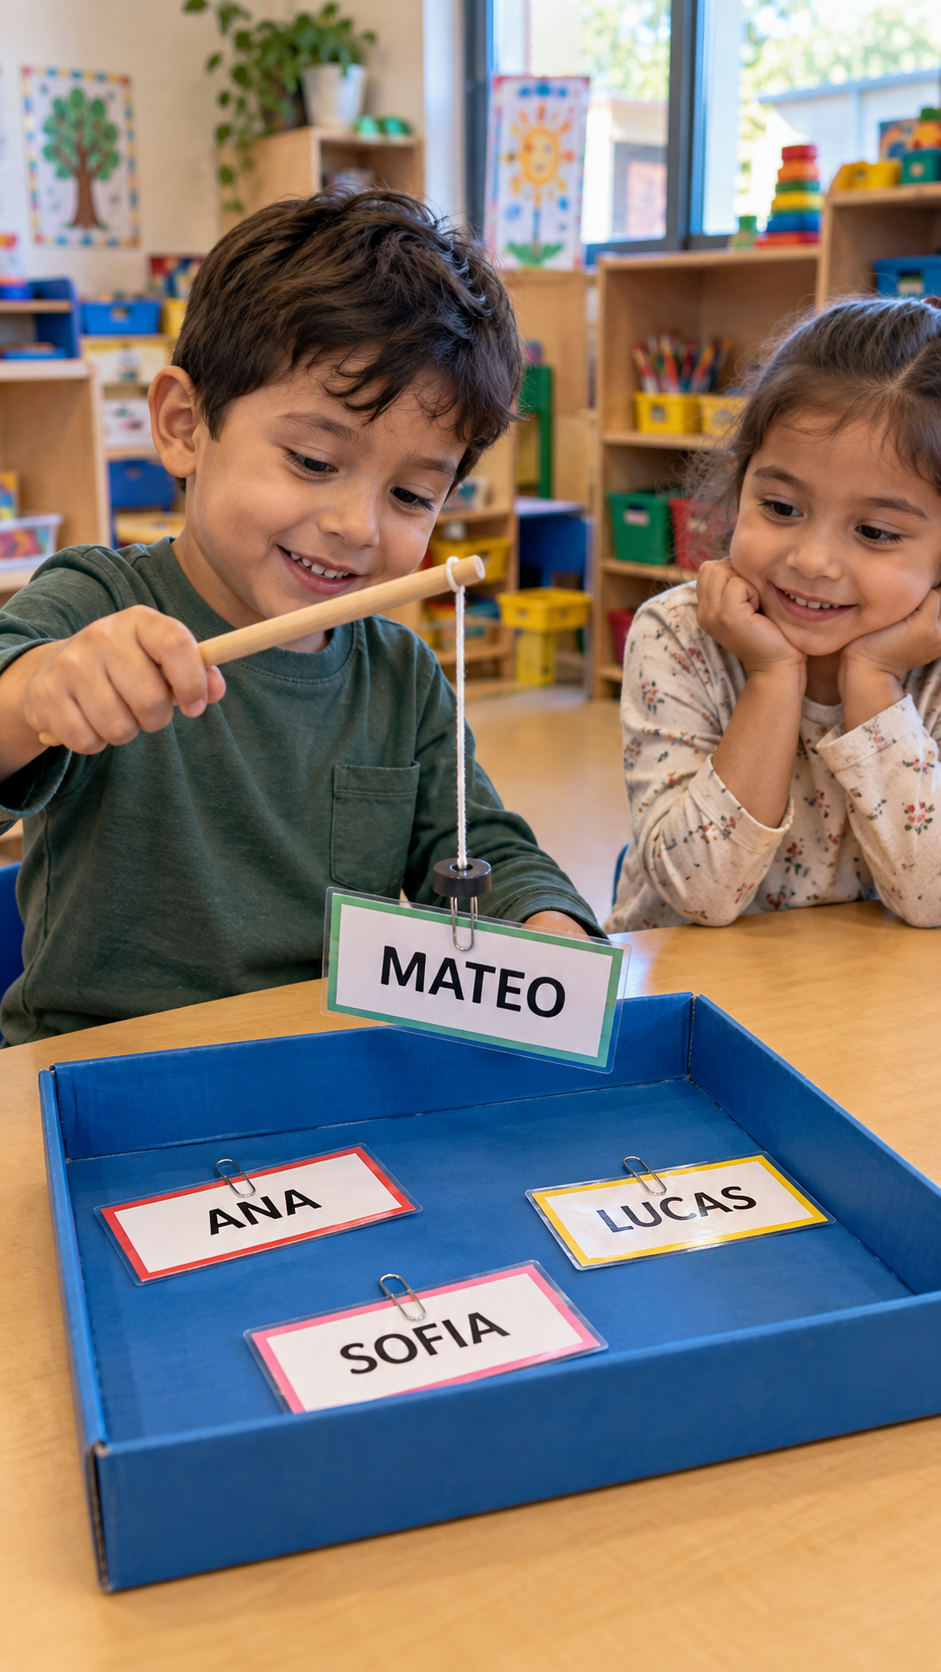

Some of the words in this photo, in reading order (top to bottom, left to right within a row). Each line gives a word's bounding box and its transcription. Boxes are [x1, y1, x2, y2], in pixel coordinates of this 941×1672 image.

[380, 945, 566, 1018] MATEO
[207, 1189, 323, 1236] ANA
[597, 1186, 757, 1233] LUCAS
[340, 1312, 510, 1375] SOFIA
